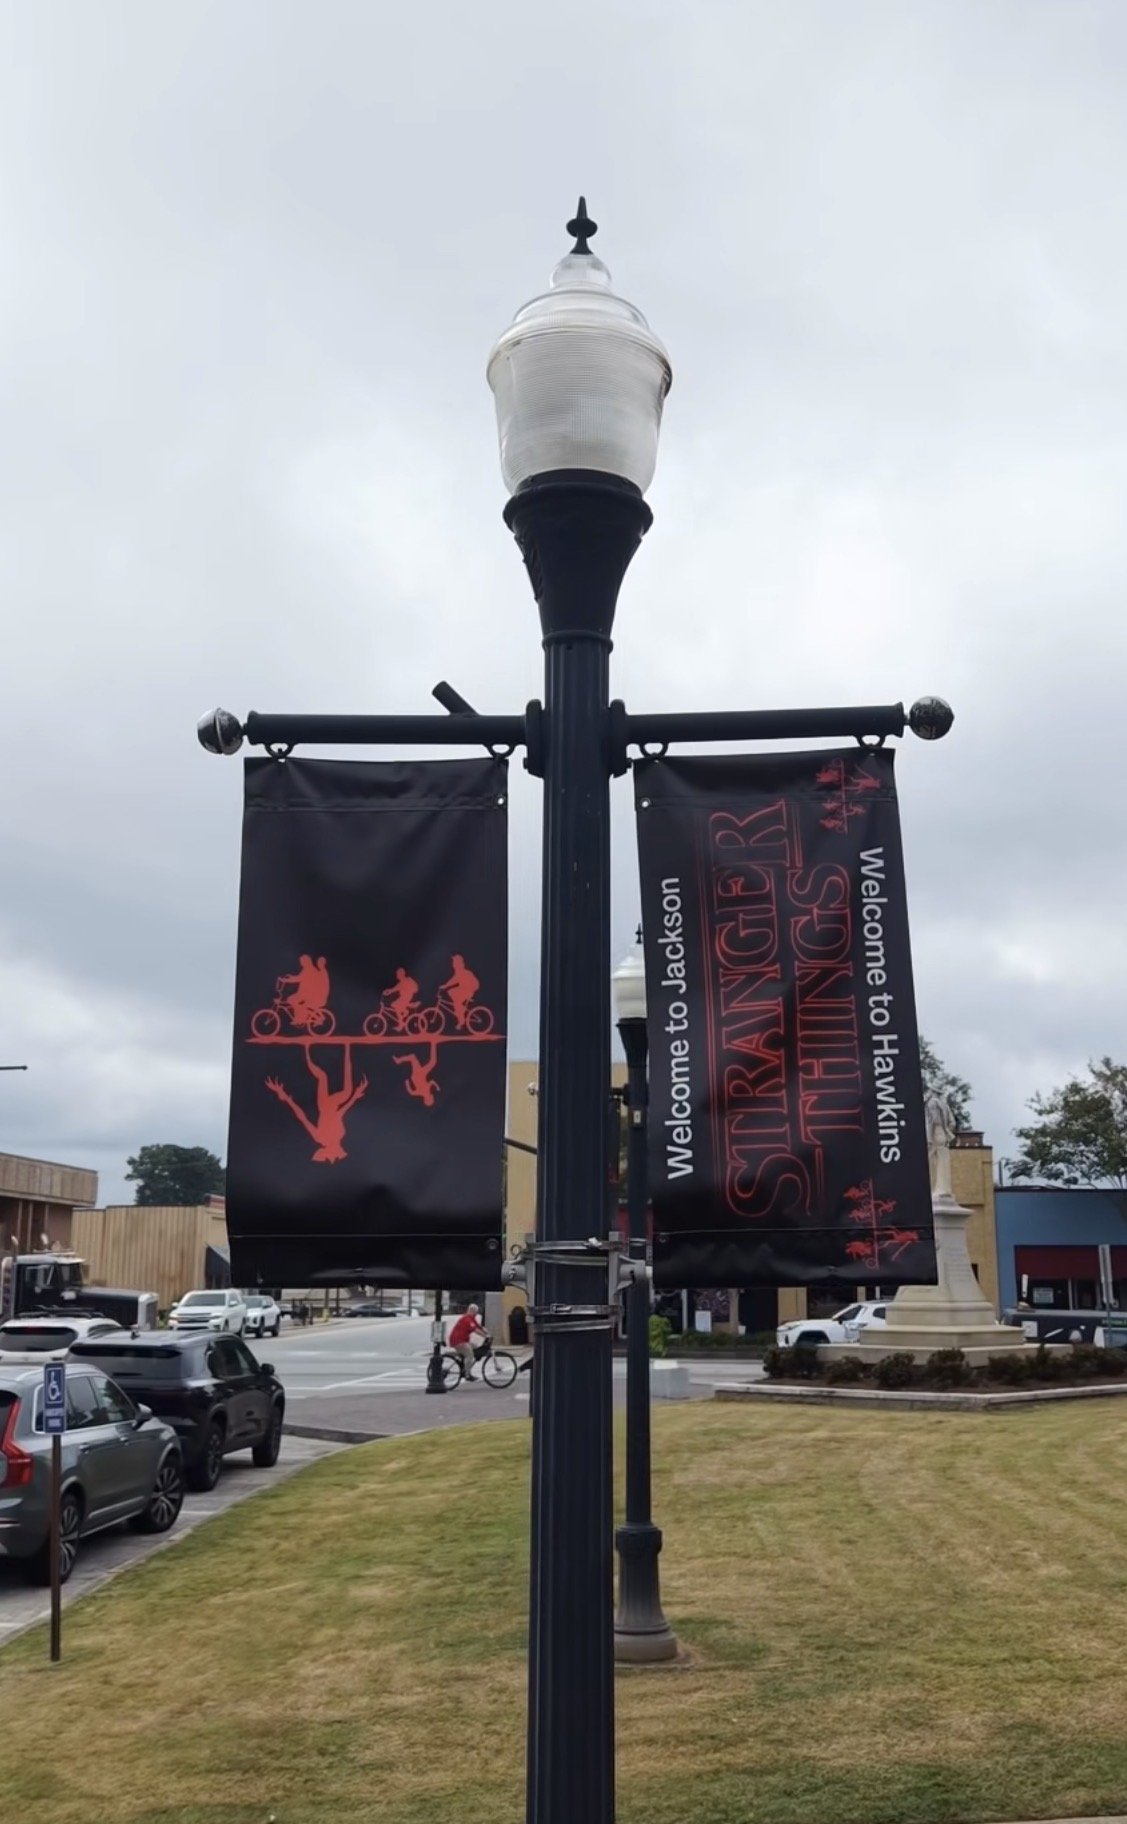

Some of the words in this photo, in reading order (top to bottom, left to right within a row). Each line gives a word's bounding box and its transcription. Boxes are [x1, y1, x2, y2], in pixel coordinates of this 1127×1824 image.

[657, 877, 687, 994] Jackson
[859, 846, 888, 986] Welcome
[665, 1001, 689, 1034] to
[709, 799, 811, 1218] STRANGER
[787, 863, 866, 1145] THINGS
[868, 992, 894, 1027] to
[664, 1039, 694, 1180] Welcome
[872, 1034, 906, 1164] Hawkins
